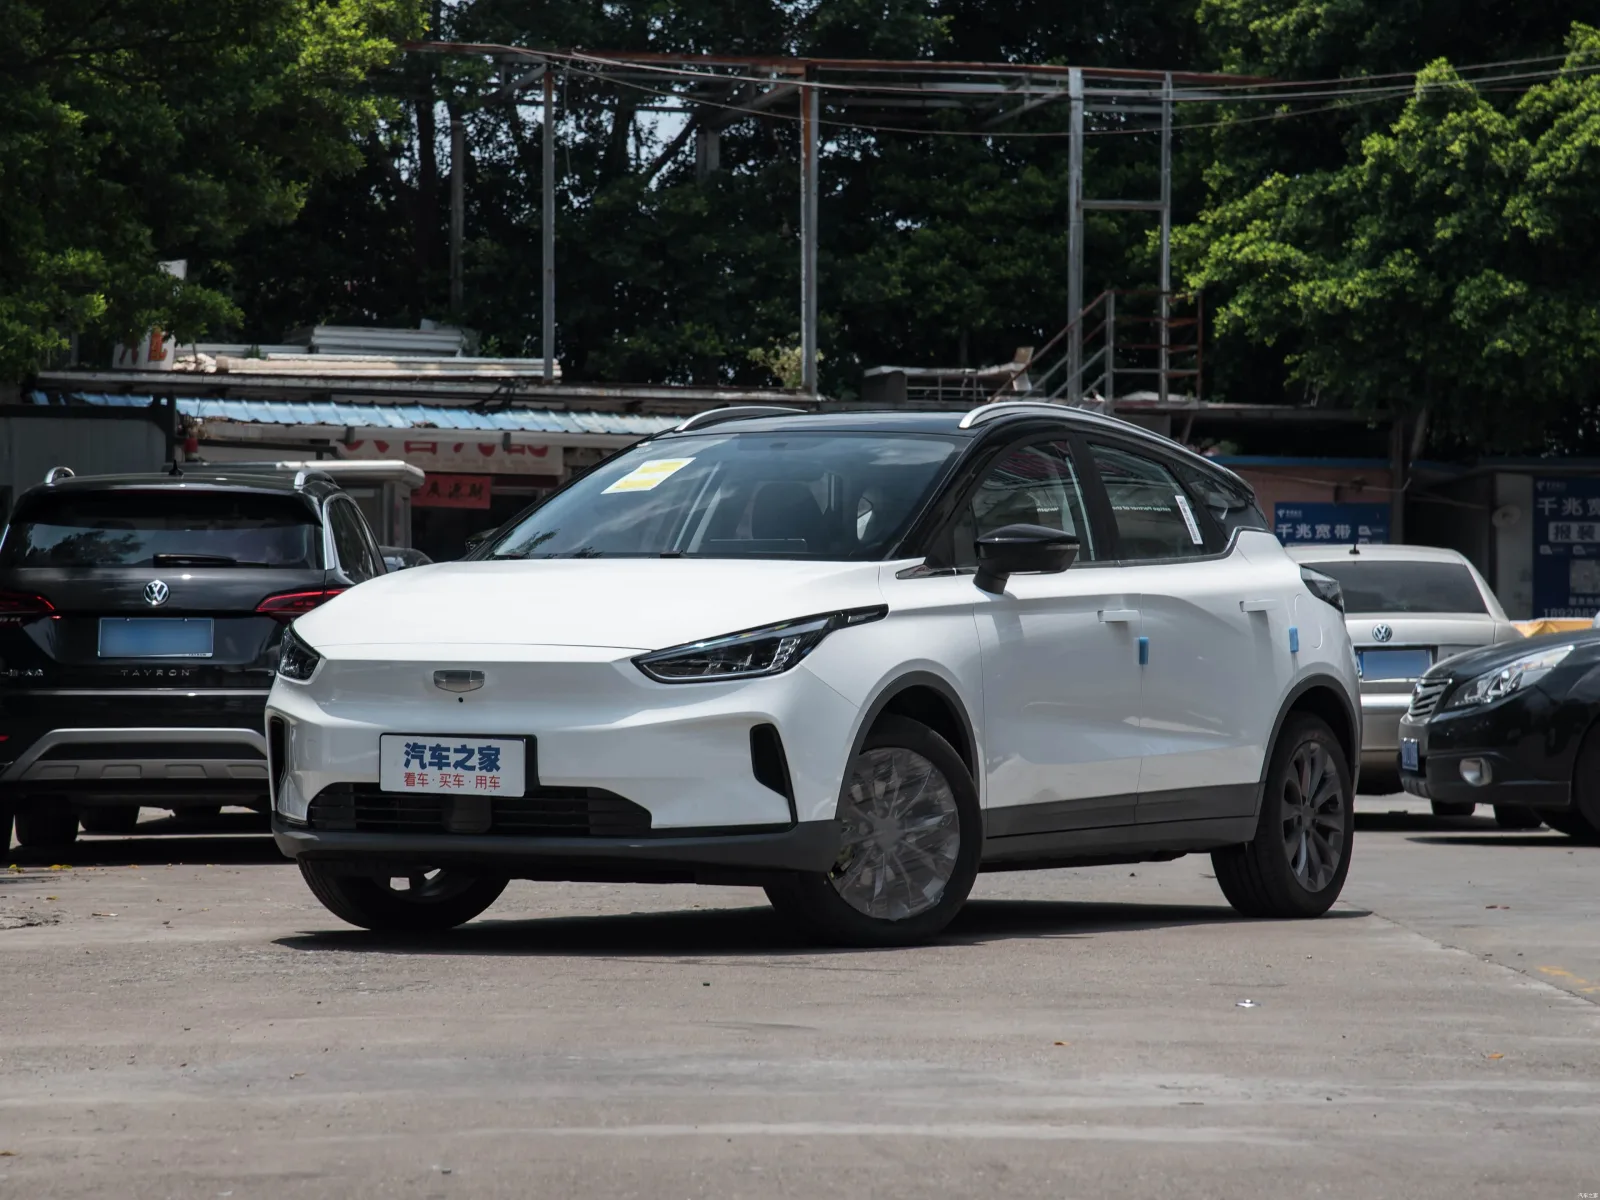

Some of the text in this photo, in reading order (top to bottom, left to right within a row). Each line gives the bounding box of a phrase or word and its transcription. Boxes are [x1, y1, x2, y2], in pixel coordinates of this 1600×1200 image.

[1276, 523, 1352, 539] 千兆宽带
[121, 669, 190, 677] TAYRON
[403, 742, 501, 772] 汽车之家
